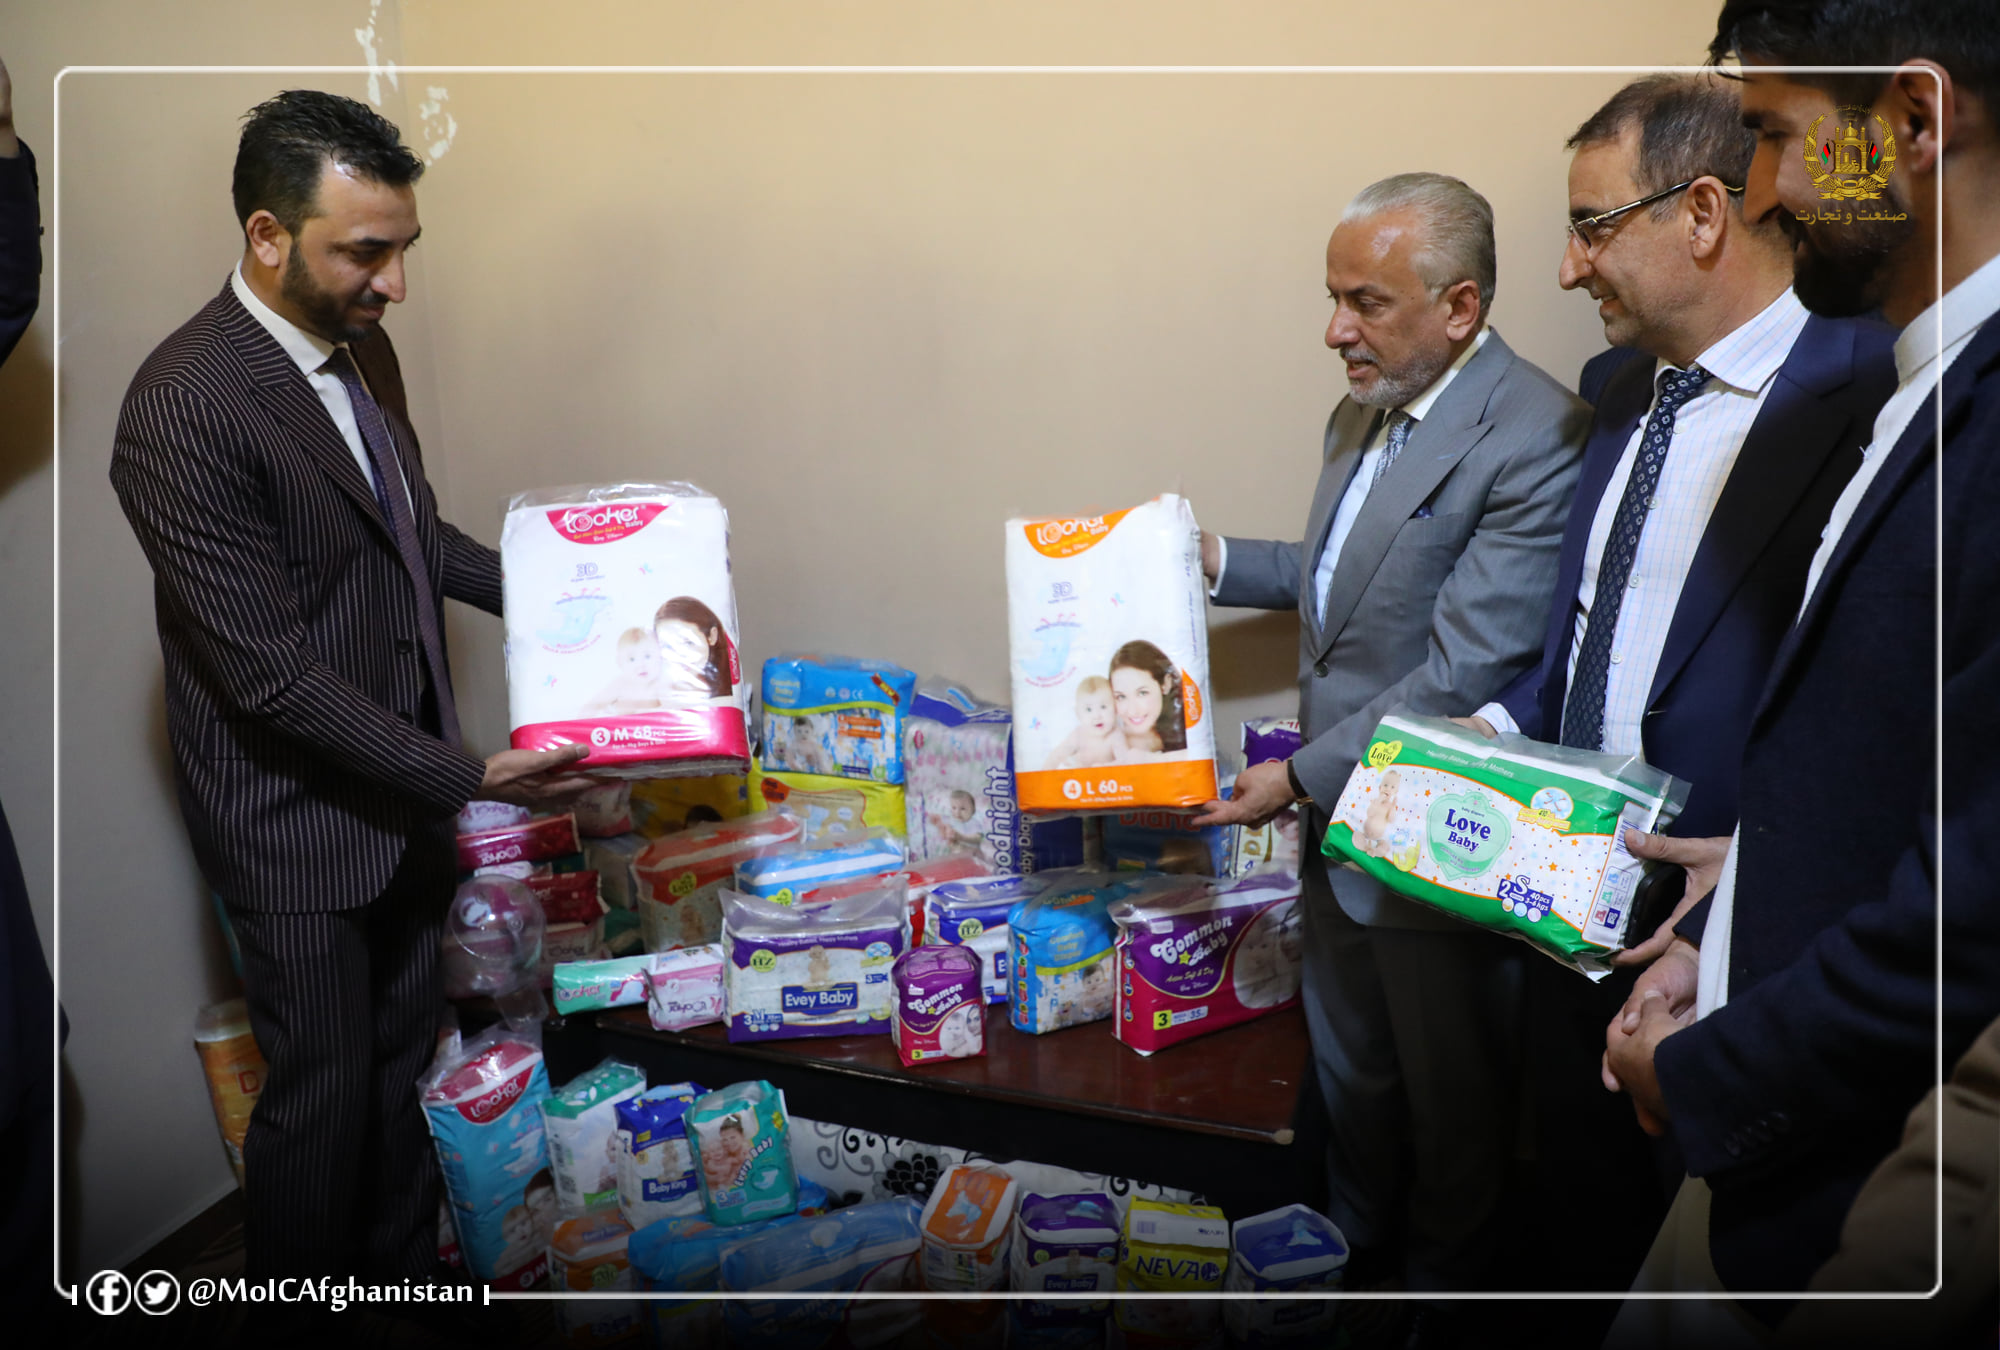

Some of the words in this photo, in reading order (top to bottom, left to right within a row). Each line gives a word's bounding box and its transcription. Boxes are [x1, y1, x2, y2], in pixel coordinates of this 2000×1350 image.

[613, 727, 630, 742] M
[633, 725, 653, 739] 68
[1086, 781, 1095, 795] L
[1098, 779, 1118, 794] 60
[983, 766, 1016, 876] oodnight
[1018, 813, 1032, 847] Diap
[1444, 808, 1491, 840] Love
[1447, 831, 1480, 853] Baby
[1498, 880, 1511, 898] 2
[1513, 874, 1531, 895] S
[784, 992, 817, 1009] Evey
[819, 989, 855, 1006] Baby
[743, 1014, 753, 1026] 3
[1158, 1012, 1168, 1027] 3
[1135, 1255, 1200, 1281] NEVA
